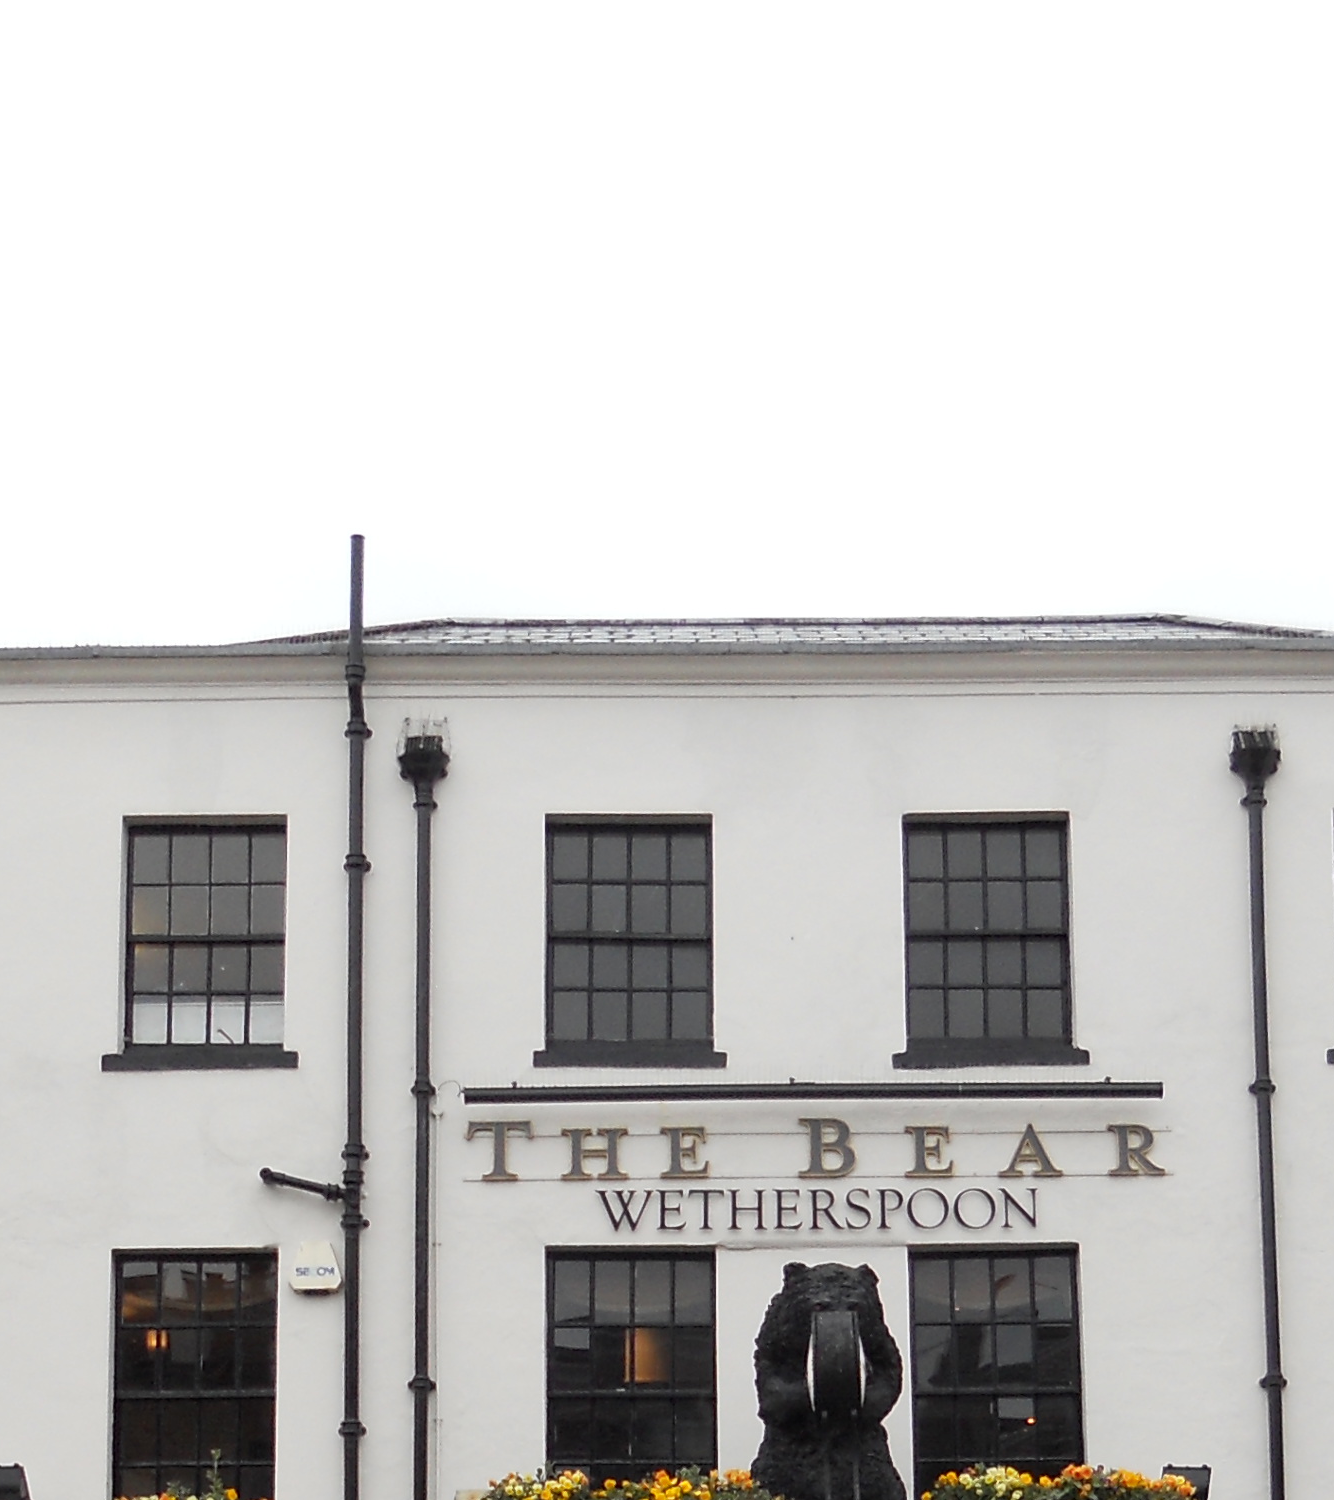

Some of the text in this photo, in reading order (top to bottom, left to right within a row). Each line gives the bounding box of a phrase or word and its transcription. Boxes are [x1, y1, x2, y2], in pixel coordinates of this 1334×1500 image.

[466, 1116, 1166, 1181] THE BEAR
[595, 1187, 1038, 1232] WETHERSPOON
[295, 1266, 334, 1276] SEOM
